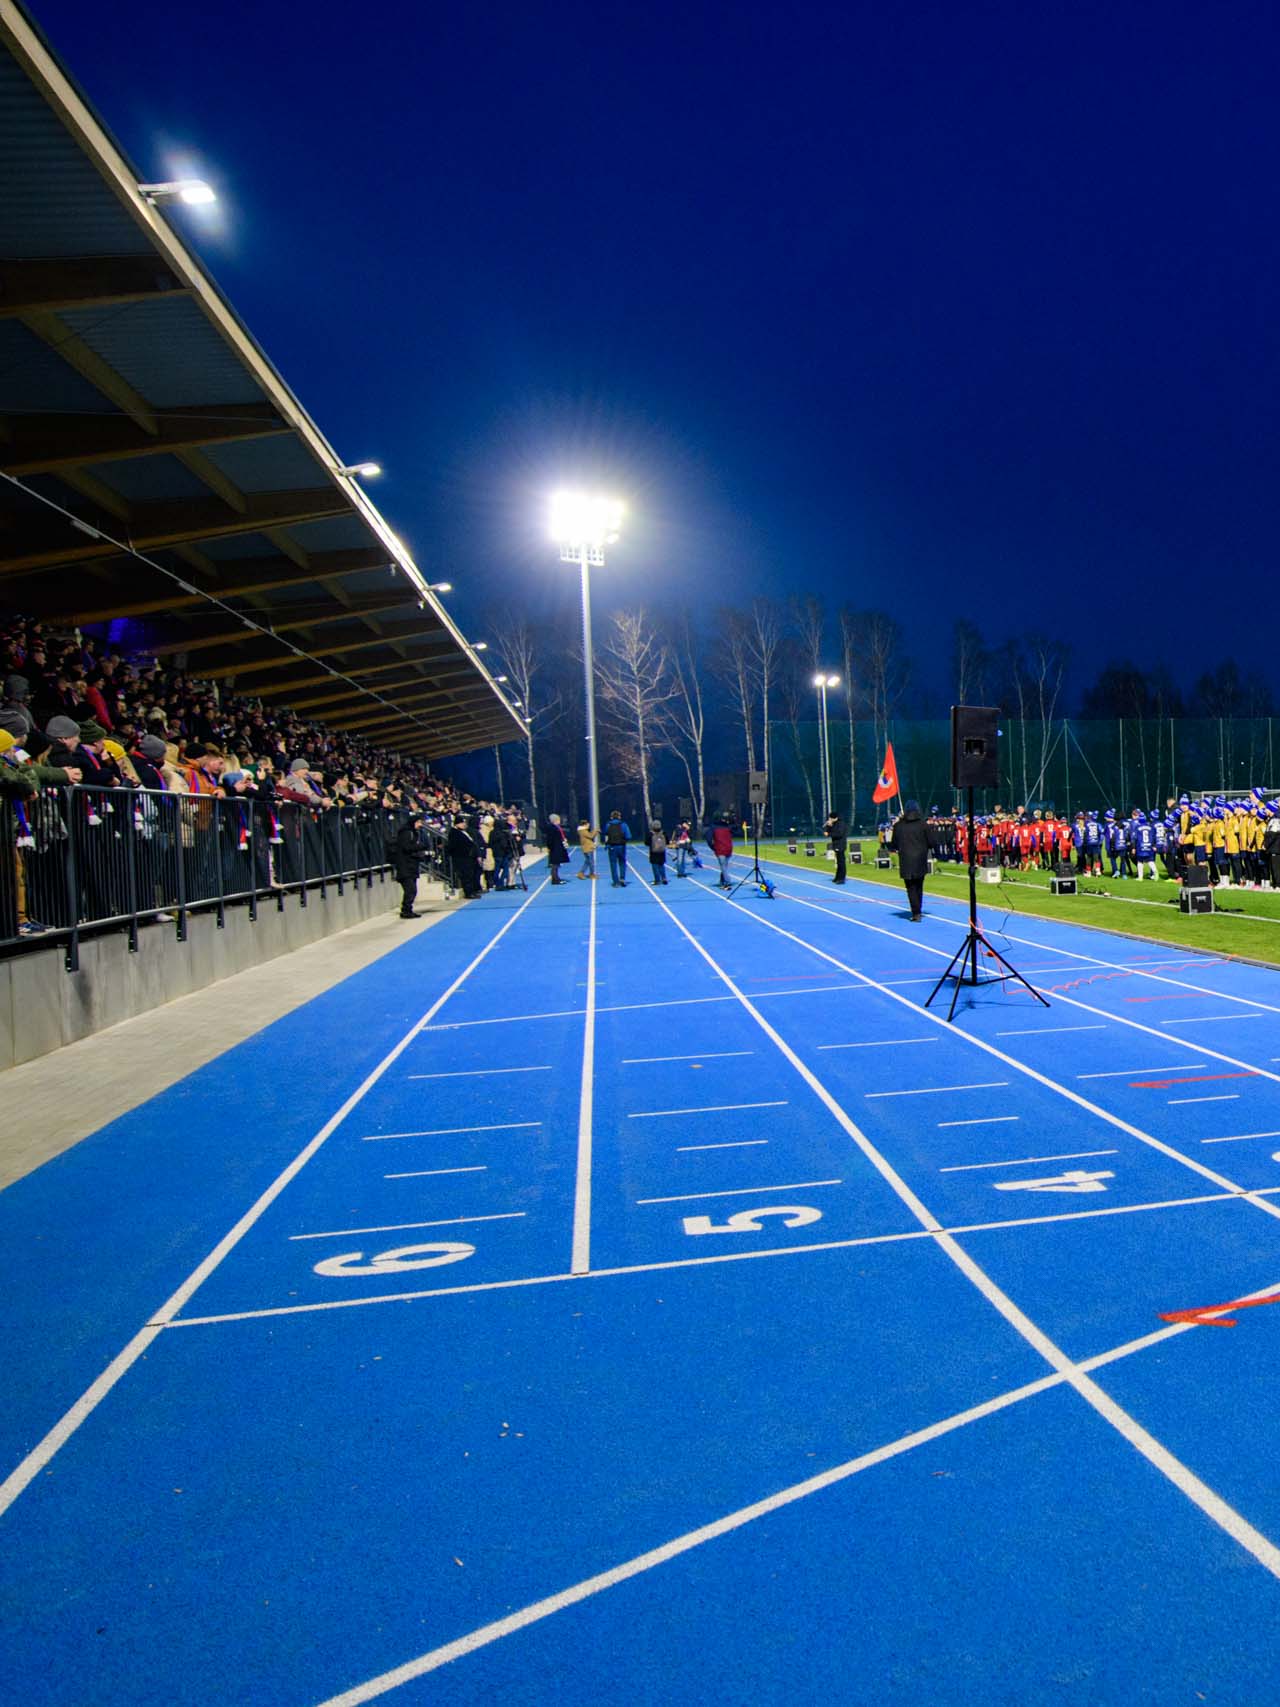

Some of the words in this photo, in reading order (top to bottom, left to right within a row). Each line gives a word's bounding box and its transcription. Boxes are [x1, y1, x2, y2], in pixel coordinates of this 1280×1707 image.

[993, 1171, 1116, 1194] 4
[682, 1205, 823, 1236] 5
[313, 1242, 476, 1277] 6
